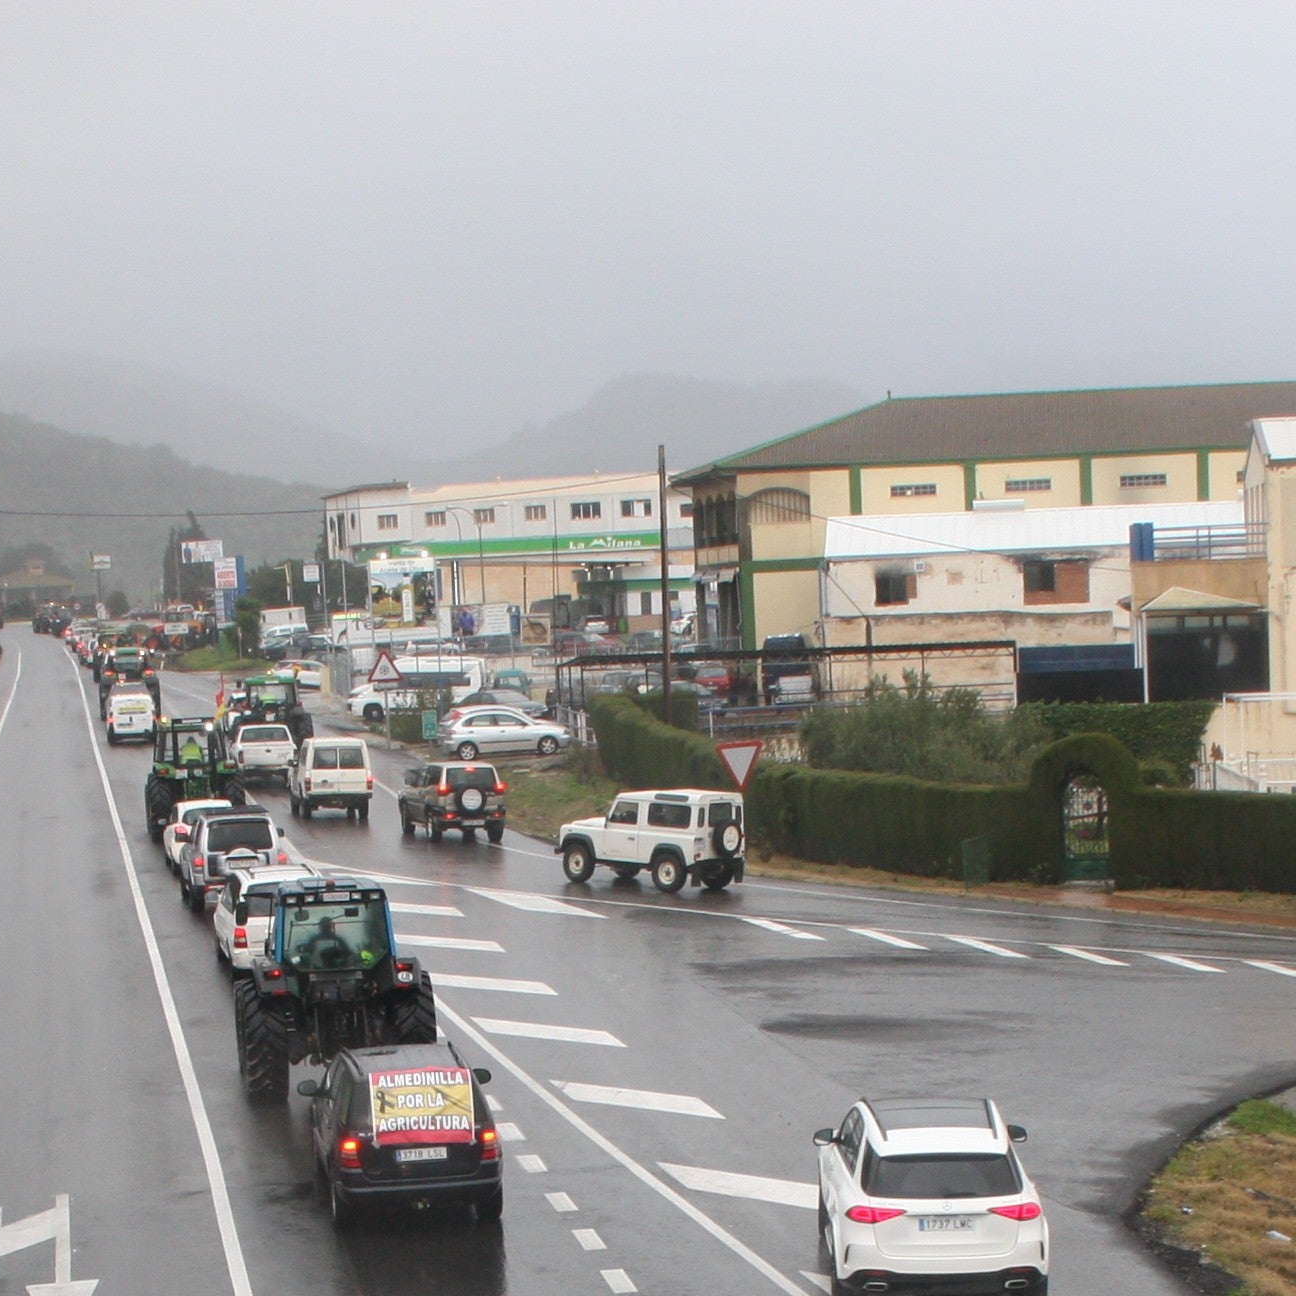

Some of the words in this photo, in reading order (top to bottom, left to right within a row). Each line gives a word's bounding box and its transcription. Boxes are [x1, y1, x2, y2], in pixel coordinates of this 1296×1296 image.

[569, 541, 585, 549] La
[591, 536, 641, 548] Milana
[378, 1071, 464, 1088] ALMEDINILLA
[397, 1093, 425, 1108] POR
[427, 1092, 445, 1107] LA
[378, 1115, 469, 1132] AGRICULTURA
[927, 1219, 951, 1229] 1737
